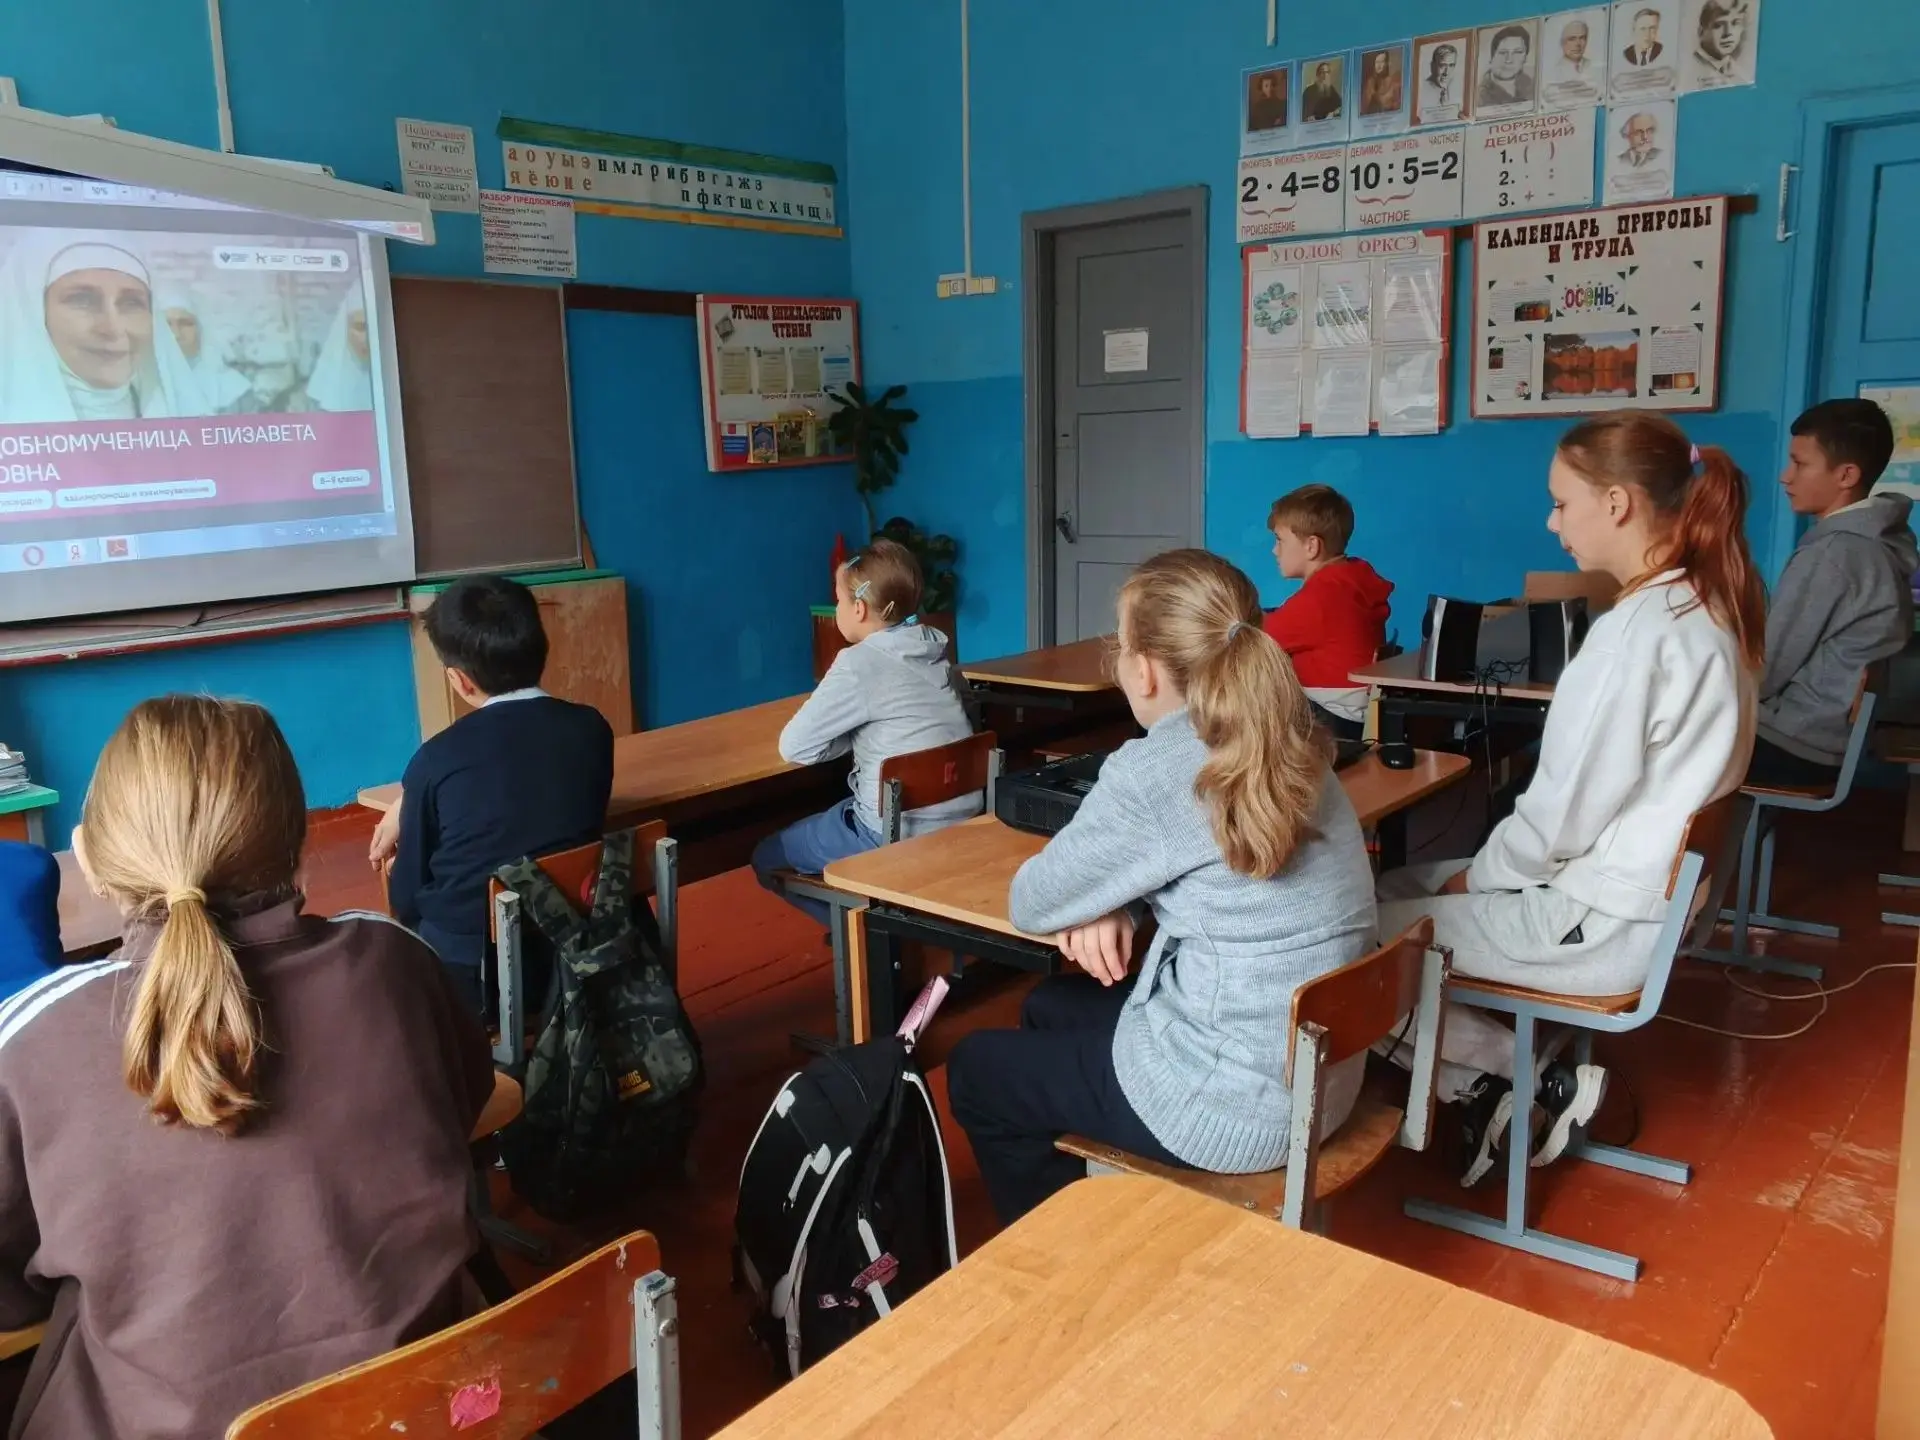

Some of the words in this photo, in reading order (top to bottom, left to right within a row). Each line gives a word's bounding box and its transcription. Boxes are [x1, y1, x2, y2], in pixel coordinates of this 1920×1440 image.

[1489, 115, 1569, 134] ПОРЯДОК
[1500, 148, 1513, 164] 1.
[1499, 170, 1515, 186] 2.
[480, 192, 513, 203] РАЗБОР
[1499, 192, 1515, 207] 3.
[1360, 209, 1411, 225] ЧАСТНОЕ
[1240, 220, 1296, 238] ПРОИЗВЕДЕНИЕ
[1487, 217, 1601, 250] КАЛЕНДАРЬ
[1617, 205, 1713, 235] ПРИРОДЫ
[1273, 243, 1342, 262] УГОЛОК
[1358, 235, 1418, 254] ОРКСЭ
[1572, 236, 1635, 262] ТРУДА
[731, 304, 769, 321] УГОЛОК
[772, 322, 812, 339] ЧТЕНИЯ
[0, 428, 192, 459] ОБНОМУЧЕНИЦА
[201, 424, 317, 446] ЕЛИЗАВЕТА
